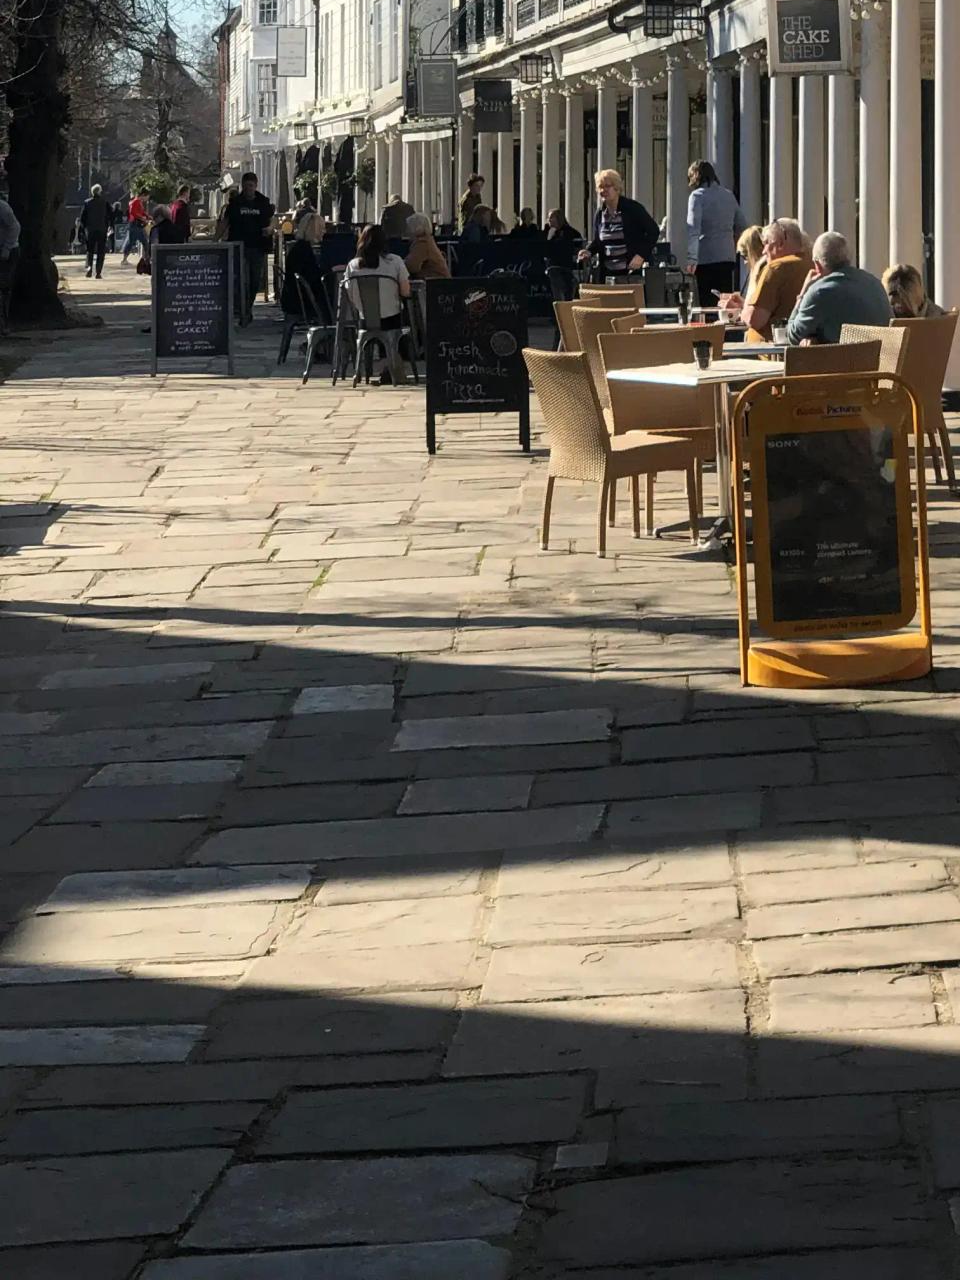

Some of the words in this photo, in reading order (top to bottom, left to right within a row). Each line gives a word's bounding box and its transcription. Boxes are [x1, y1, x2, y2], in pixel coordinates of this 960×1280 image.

[781, 16, 811, 30] THE
[783, 30, 830, 44] CAKE
[783, 45, 824, 60] SHED
[179, 254, 201, 262] CAKE
[438, 340, 485, 361] Fresh
[441, 379, 487, 401] Pizza
[768, 439, 801, 449] SONY
